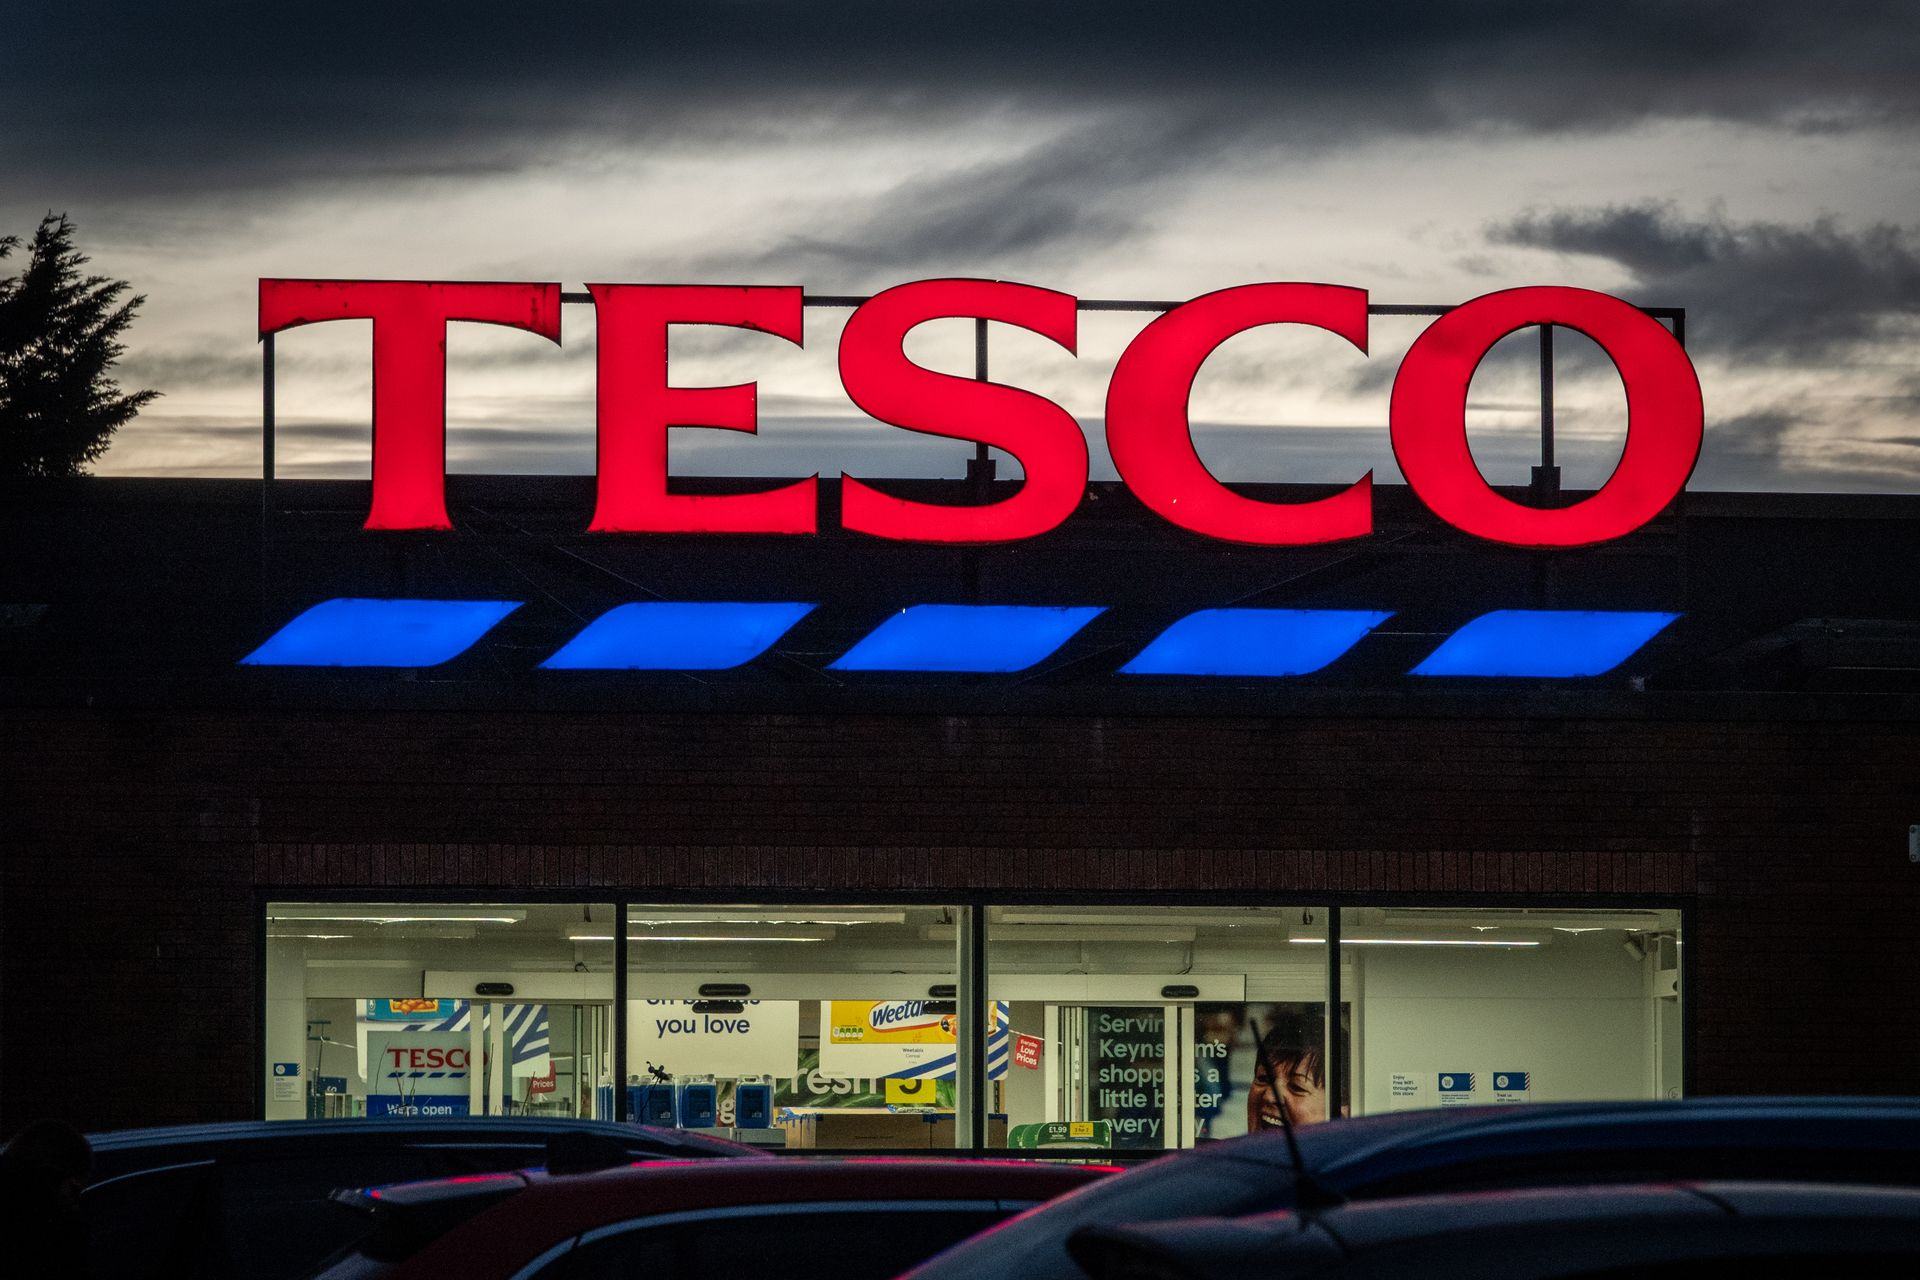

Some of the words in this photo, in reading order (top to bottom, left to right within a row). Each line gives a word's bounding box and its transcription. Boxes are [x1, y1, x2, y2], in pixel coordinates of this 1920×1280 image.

[259, 278, 1704, 548] TESCO
[872, 1000, 925, 1027] Weeta
[1099, 1014, 1165, 1033] Servin
[656, 1019, 696, 1038] you
[704, 1015, 750, 1034] love
[1016, 1053, 1037, 1065] Prices
[1020, 1045, 1036, 1055] Low
[1099, 1039, 1228, 1062] Keynsm's
[532, 1080, 554, 1088] Prices
[790, 1068, 877, 1094] res
[1099, 1063, 1200, 1087] shopps
[1207, 1068, 1220, 1083] a
[1099, 1088, 1148, 1108] little
[387, 1103, 418, 1116] Were
[422, 1105, 452, 1116] open
